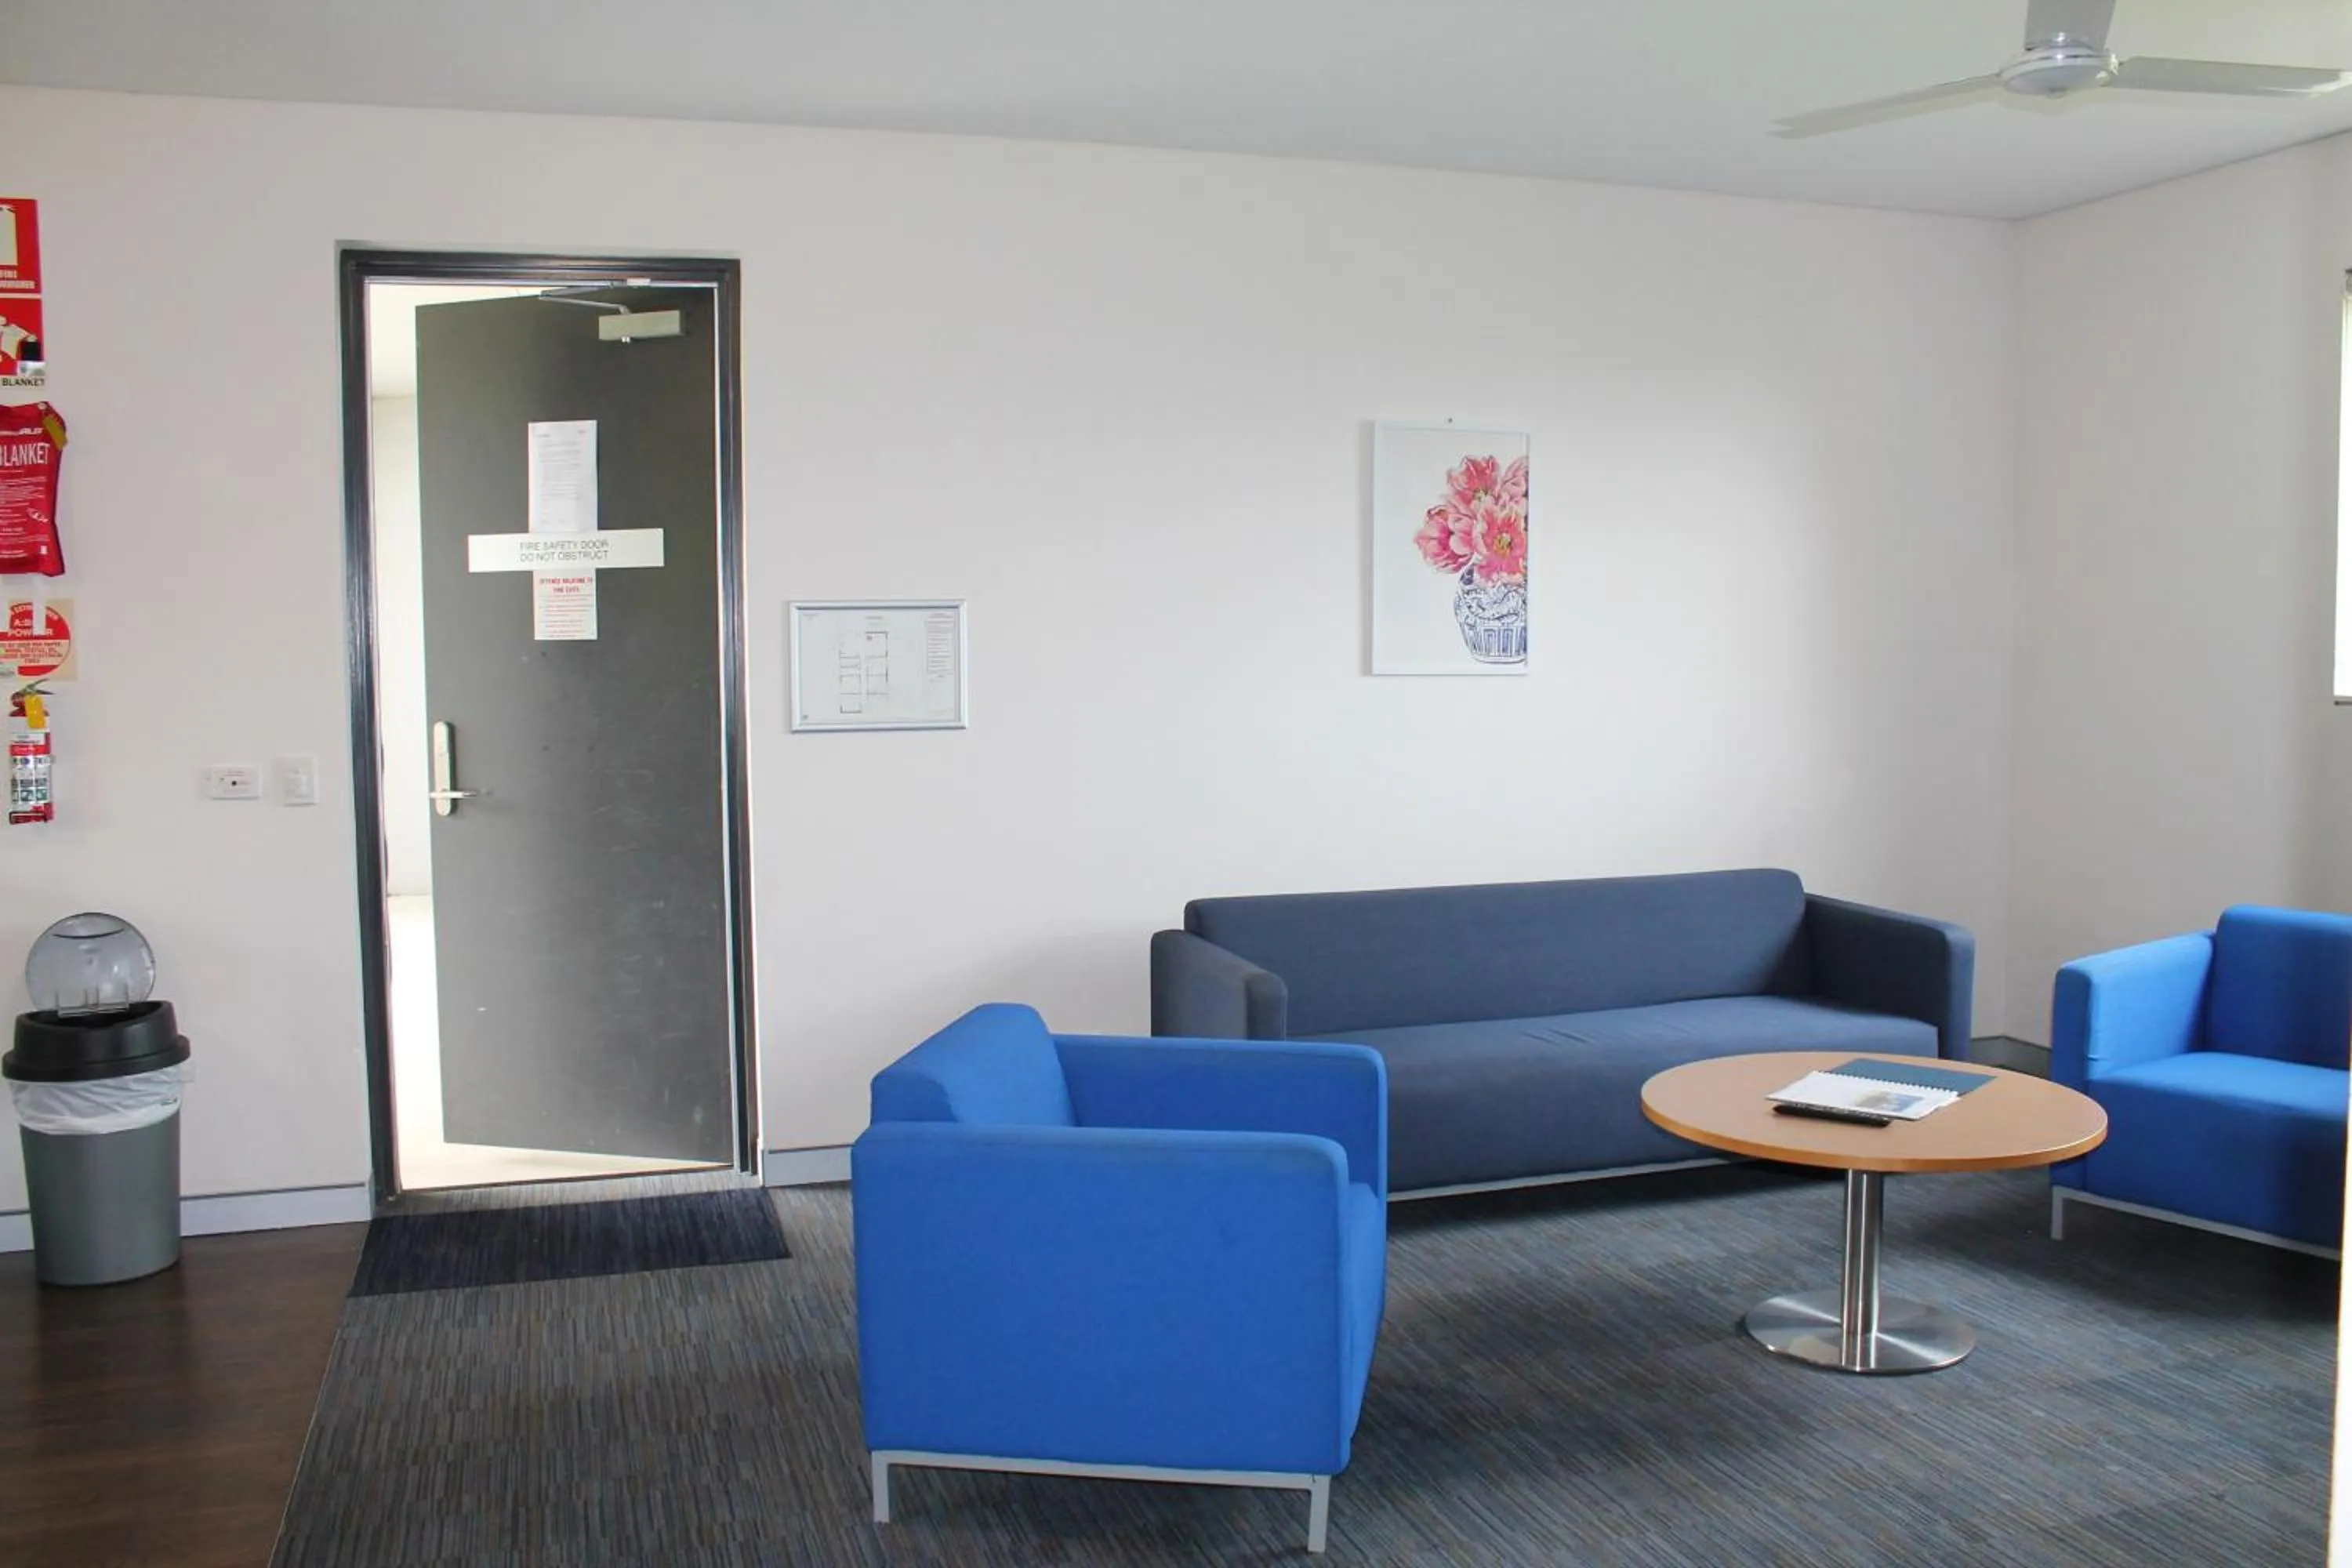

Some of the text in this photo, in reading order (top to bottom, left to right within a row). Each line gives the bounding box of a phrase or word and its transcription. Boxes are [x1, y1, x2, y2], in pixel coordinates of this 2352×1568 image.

[2, 378, 45, 387] BLANKET
[519, 539, 609, 551] FIRE SAFETY DOOR
[520, 550, 609, 562] DO NOT OBSTRUCT
[8, 628, 53, 637] POWR
